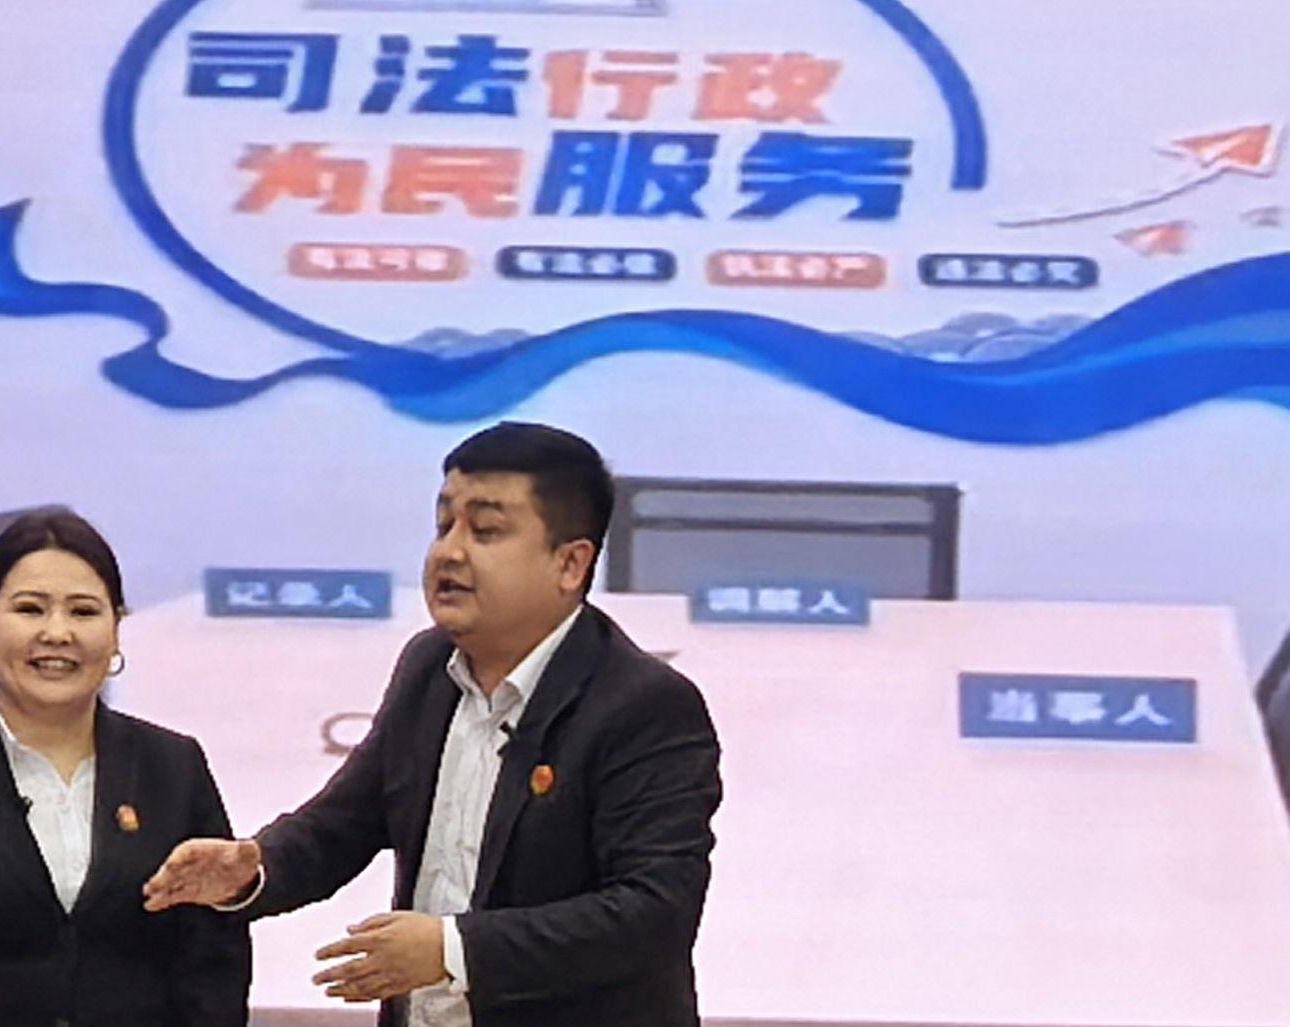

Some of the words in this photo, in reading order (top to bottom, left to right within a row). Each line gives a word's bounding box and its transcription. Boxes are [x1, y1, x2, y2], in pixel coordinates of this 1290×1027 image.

[184, 31, 843, 125] 司法行政
[232, 130, 915, 221] 为民服务
